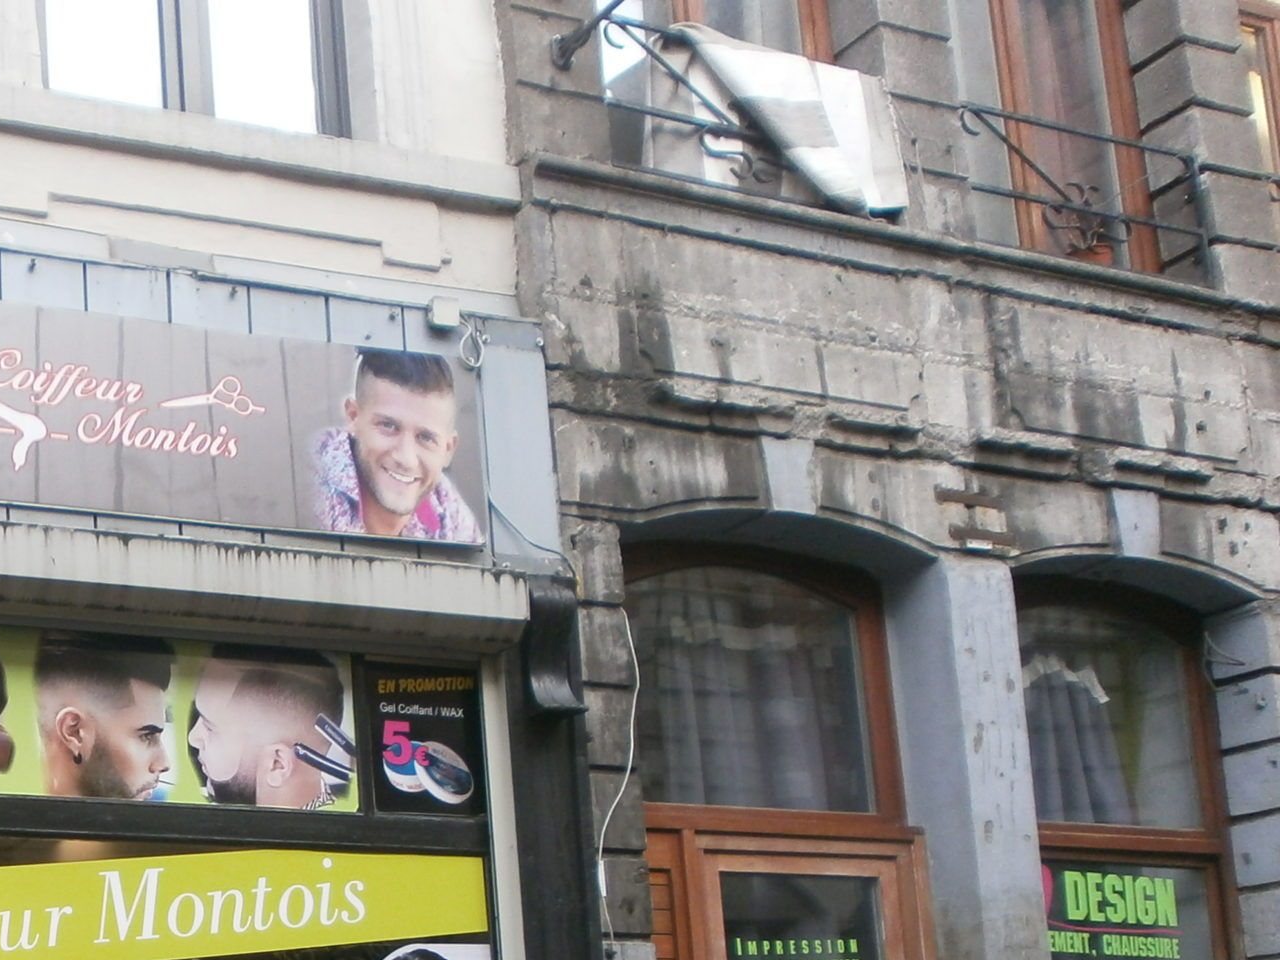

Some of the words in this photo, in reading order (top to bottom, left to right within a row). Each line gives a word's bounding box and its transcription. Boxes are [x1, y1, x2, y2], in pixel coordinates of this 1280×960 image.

[76, 407, 238, 458] Montois
[378, 679, 395, 693] EN
[399, 677, 475, 693] PROMOTION
[380, 702, 396, 713] Gel
[398, 703, 433, 716] Coiffant
[440, 706, 464, 717] WAX
[382, 719, 431, 766] 5€
[93, 857, 368, 946] Montois
[1064, 870, 1178, 927] DESIGN
[736, 937, 858, 956] IMPRESSION
[1103, 935, 1181, 959] CHAUSSURE
